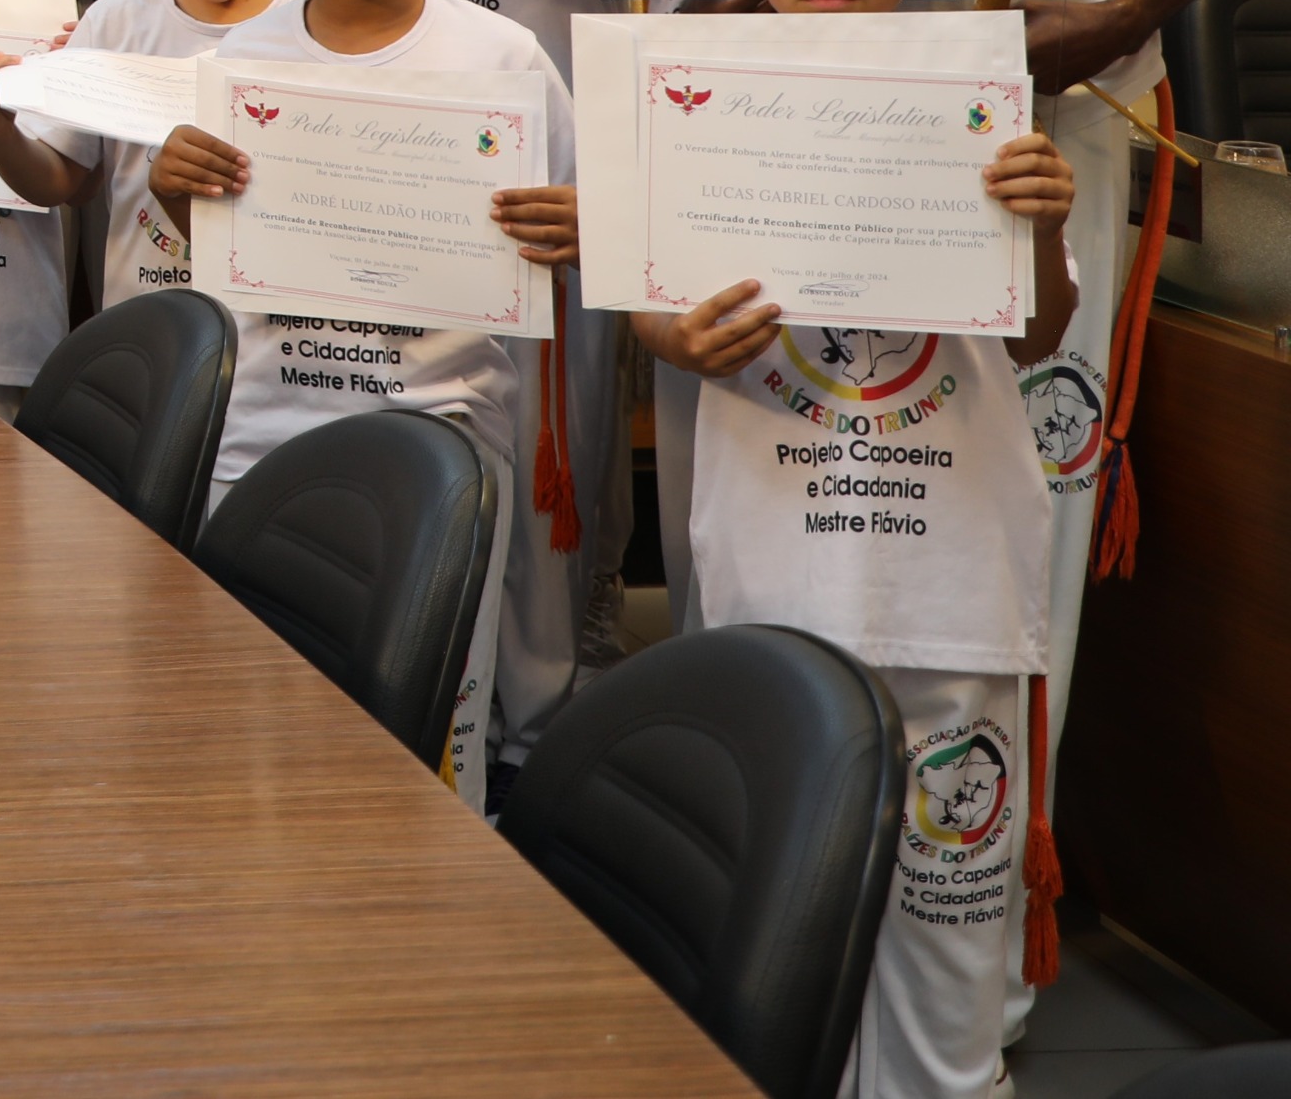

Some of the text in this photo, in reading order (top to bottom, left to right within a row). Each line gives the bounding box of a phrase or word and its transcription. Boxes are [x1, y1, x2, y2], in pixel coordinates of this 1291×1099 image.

[720, 92, 946, 137] Poder Legislativo
[286, 113, 460, 149] Poder Legislativo
[675, 142, 988, 171] O Vereador Robson Alencar de Souza, no uso das atribuições qu
[291, 191, 471, 226] ANDRÉ LUIZ ADÃO HORTA
[701, 183, 979, 213] LUCAS GABRIEL CARDOSO RAMOS
[137, 208, 180, 256] RAÍZES
[685, 210, 745, 224] Certificado
[746, 215, 760, 225] de
[762, 217, 851, 231] Reconhecimento
[853, 222, 893, 233] Público
[896, 227, 914, 235] por
[937, 227, 1002, 239] participação
[690, 223, 719, 233] como
[720, 225, 751, 236] atleta
[768, 228, 826, 241] Associação
[827, 233, 842, 241] de
[843, 232, 890, 244] Capoeira
[893, 233, 926, 246] Raizes
[928, 235, 942, 247] do
[944, 237, 987, 249] Triunfo.
[138, 266, 191, 287] Projeto
[281, 340, 401, 365] e Cidadania
[280, 366, 404, 395] Mestre Flávio
[763, 369, 956, 436] RAÍZES DO TRIUNFO
[776, 440, 953, 473] Projeto Capoeira
[806, 474, 926, 500] e Cidadania
[805, 509, 927, 536] Mestre Flávio
[906, 724, 970, 765] ASSOCIAÇÃO
[940, 850, 966, 864] DO
[969, 806, 1012, 859] TRIUNFO
[951, 857, 1012, 885] Capoeira
[903, 884, 1004, 905] e Cidadania
[900, 899, 1004, 925] Mestre Flávio
